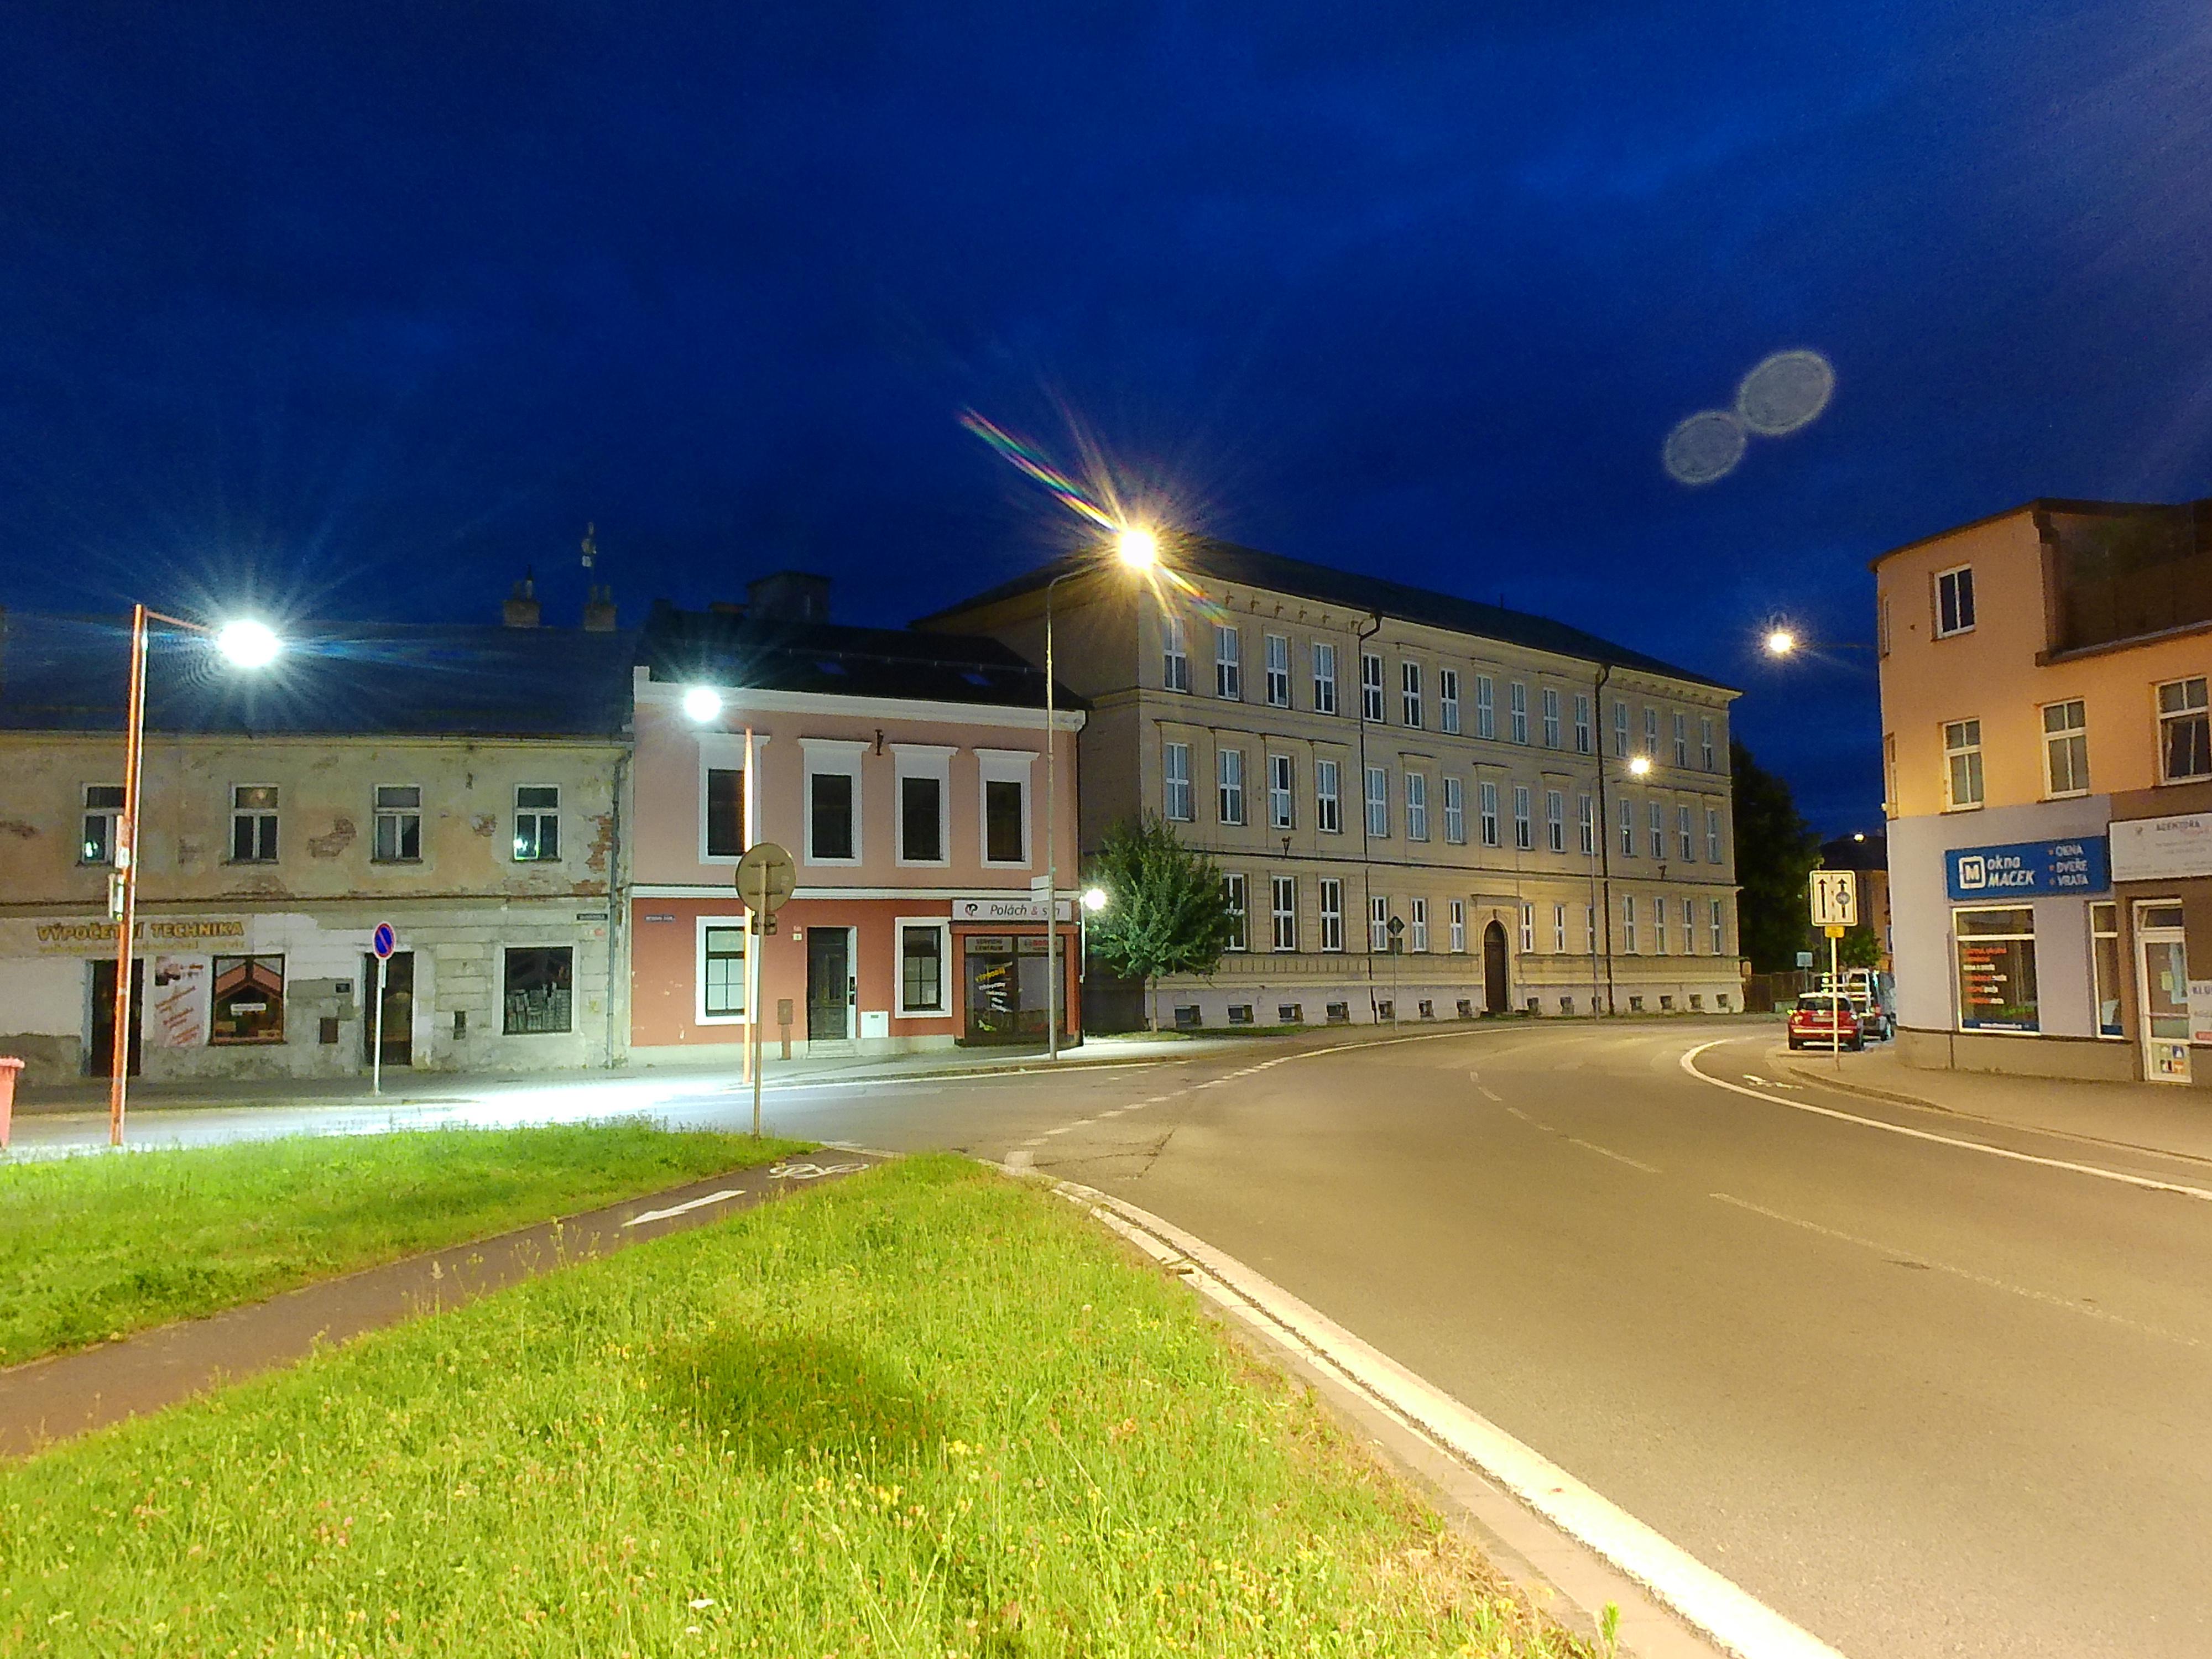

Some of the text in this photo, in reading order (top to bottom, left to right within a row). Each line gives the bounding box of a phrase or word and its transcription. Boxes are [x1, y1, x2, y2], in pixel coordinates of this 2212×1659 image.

[2055, 844, 2084, 857] OKNA
[1987, 870, 2035, 888] MACEK
[2057, 873, 2089, 886] VRATA
[990, 904, 1060, 916] Polách & sn
[36, 921, 245, 941] VÝPOČETÍ TECHNIKA
